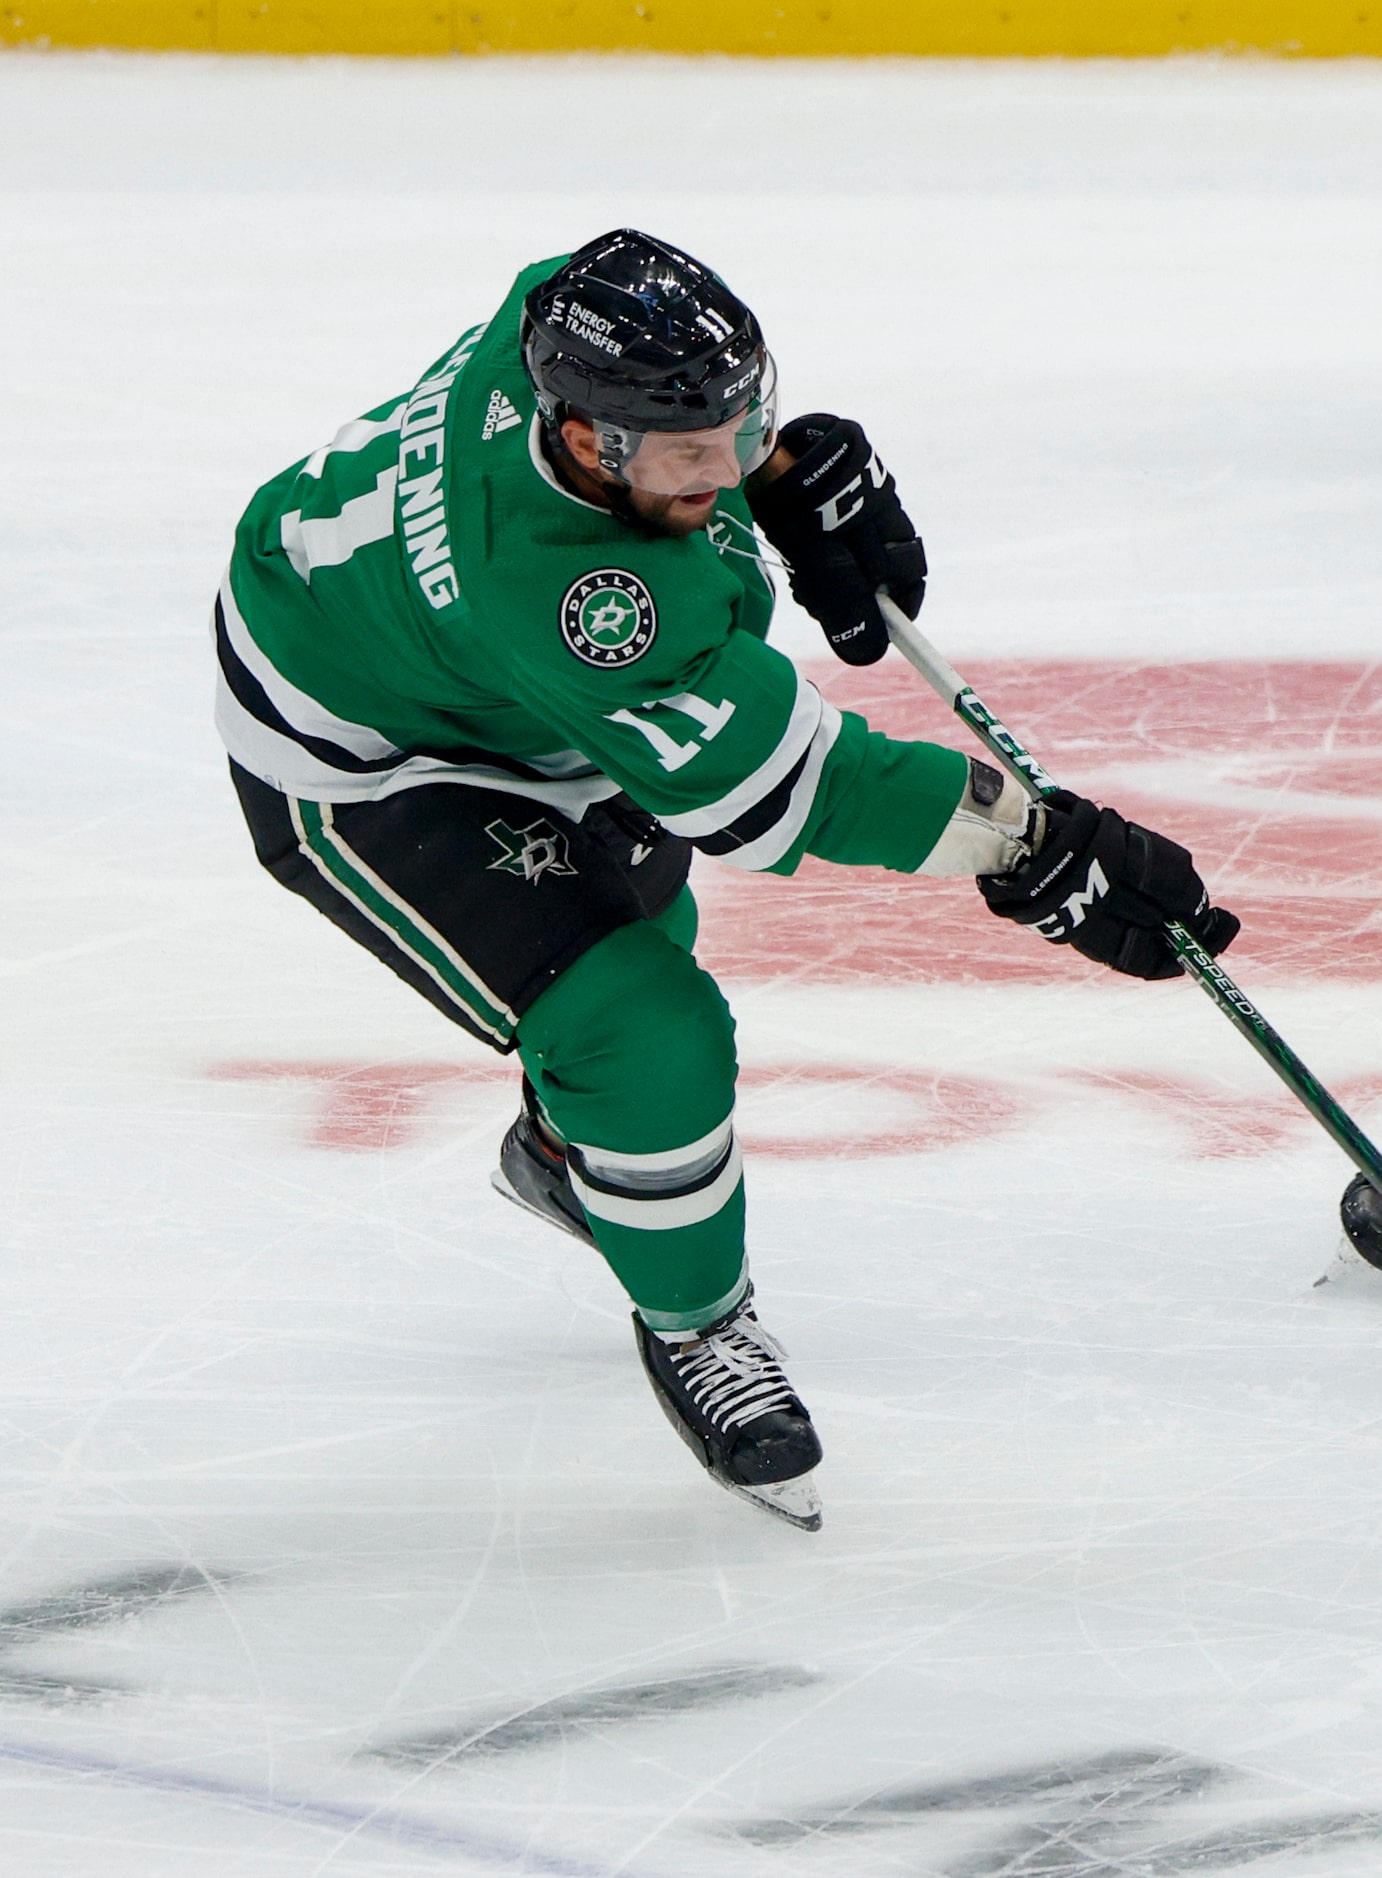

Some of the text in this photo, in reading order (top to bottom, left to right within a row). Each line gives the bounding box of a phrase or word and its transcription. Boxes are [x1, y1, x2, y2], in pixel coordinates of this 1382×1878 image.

[565, 315, 623, 357] TRANSFER
[568, 302, 616, 334] ENERGY
[696, 308, 734, 343] 11
[723, 363, 760, 399] CCM
[481, 389, 502, 441] adidas
[399, 322, 488, 610] LENDENING
[803, 442, 849, 486] GLENDENING
[568, 576, 649, 612] DALLAS
[573, 632, 648, 661] STARS
[831, 620, 866, 644] CCM
[602, 691, 737, 773] 11
[961, 693, 1056, 789] CCM
[1030, 850, 1074, 897] GLENDENING
[1026, 857, 1110, 939] CM
[1163, 919, 1256, 1016] JETSPEED
